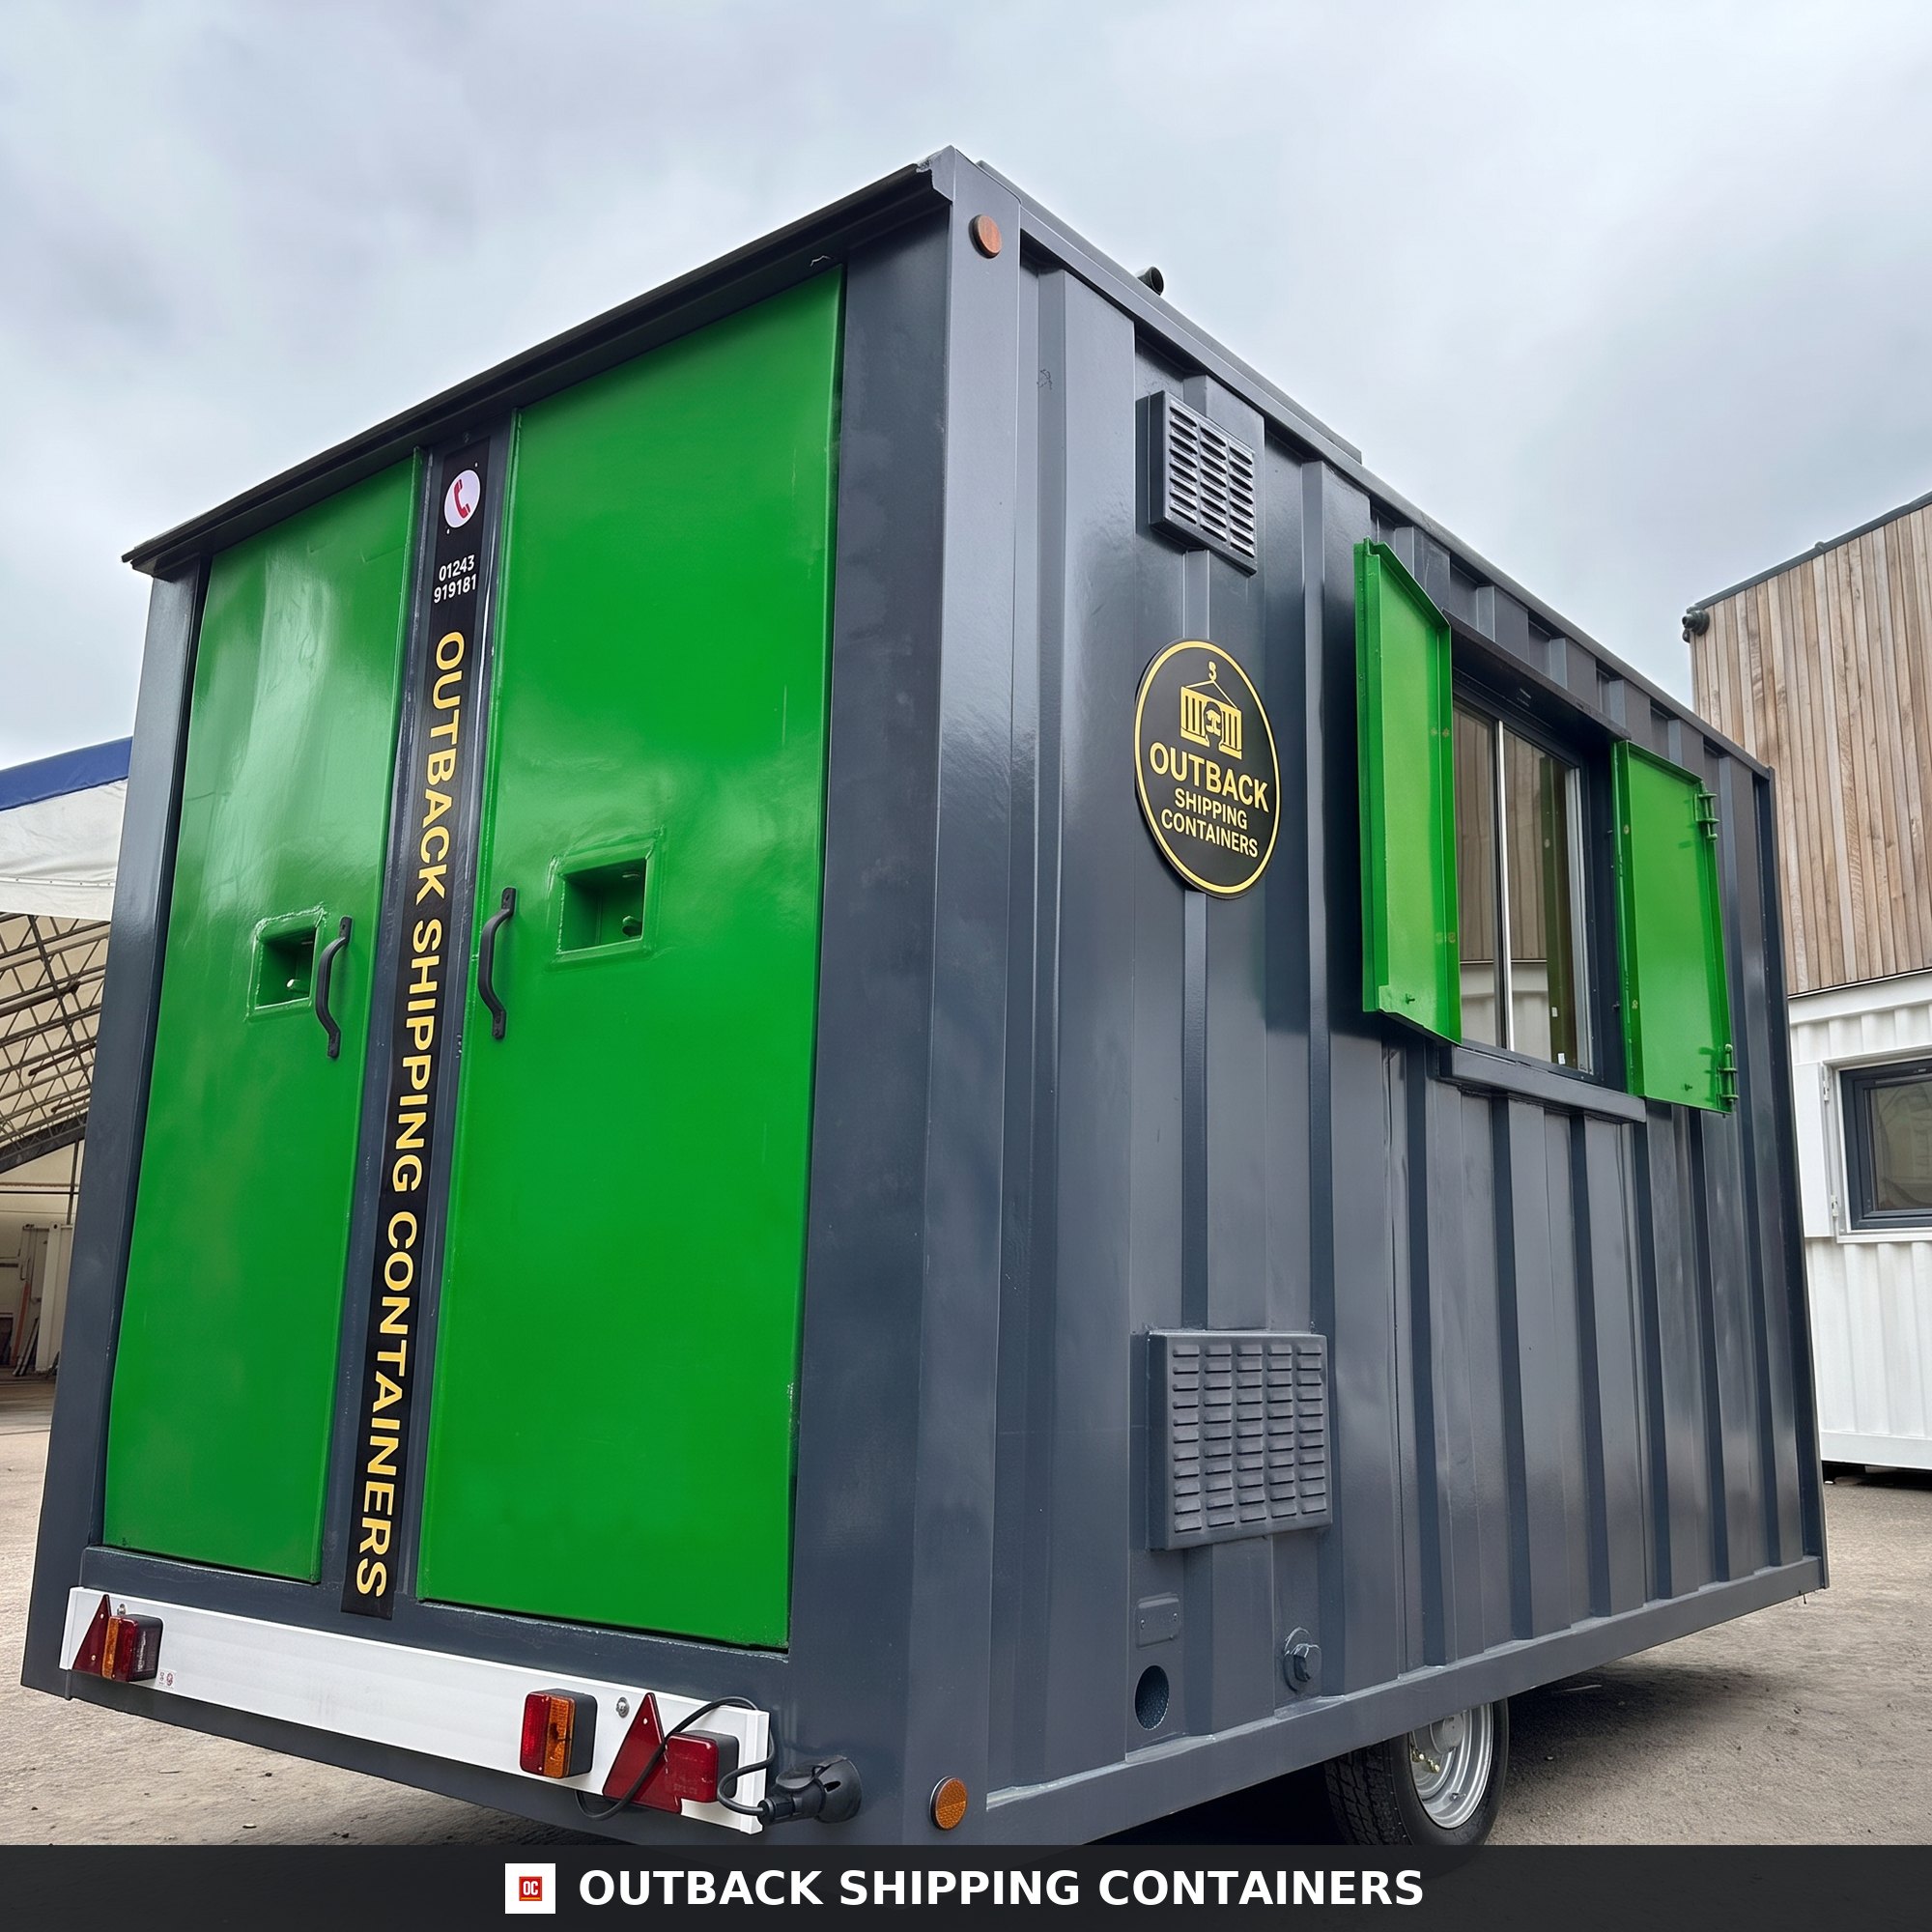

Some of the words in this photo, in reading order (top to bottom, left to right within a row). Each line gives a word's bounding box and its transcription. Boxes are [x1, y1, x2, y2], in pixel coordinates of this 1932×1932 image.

[433, 573, 477, 604] 919181
[439, 554, 475, 582] 01243
[416, 631, 465, 903] OUTBACK
[1149, 741, 1269, 812] OUTBACK
[1160, 808, 1259, 858] CONTAINERS
[1175, 787, 1248, 831] SHIPPING
[392, 919, 442, 1192] SHIPPING
[355, 1211, 417, 1597] CONTAINERS
